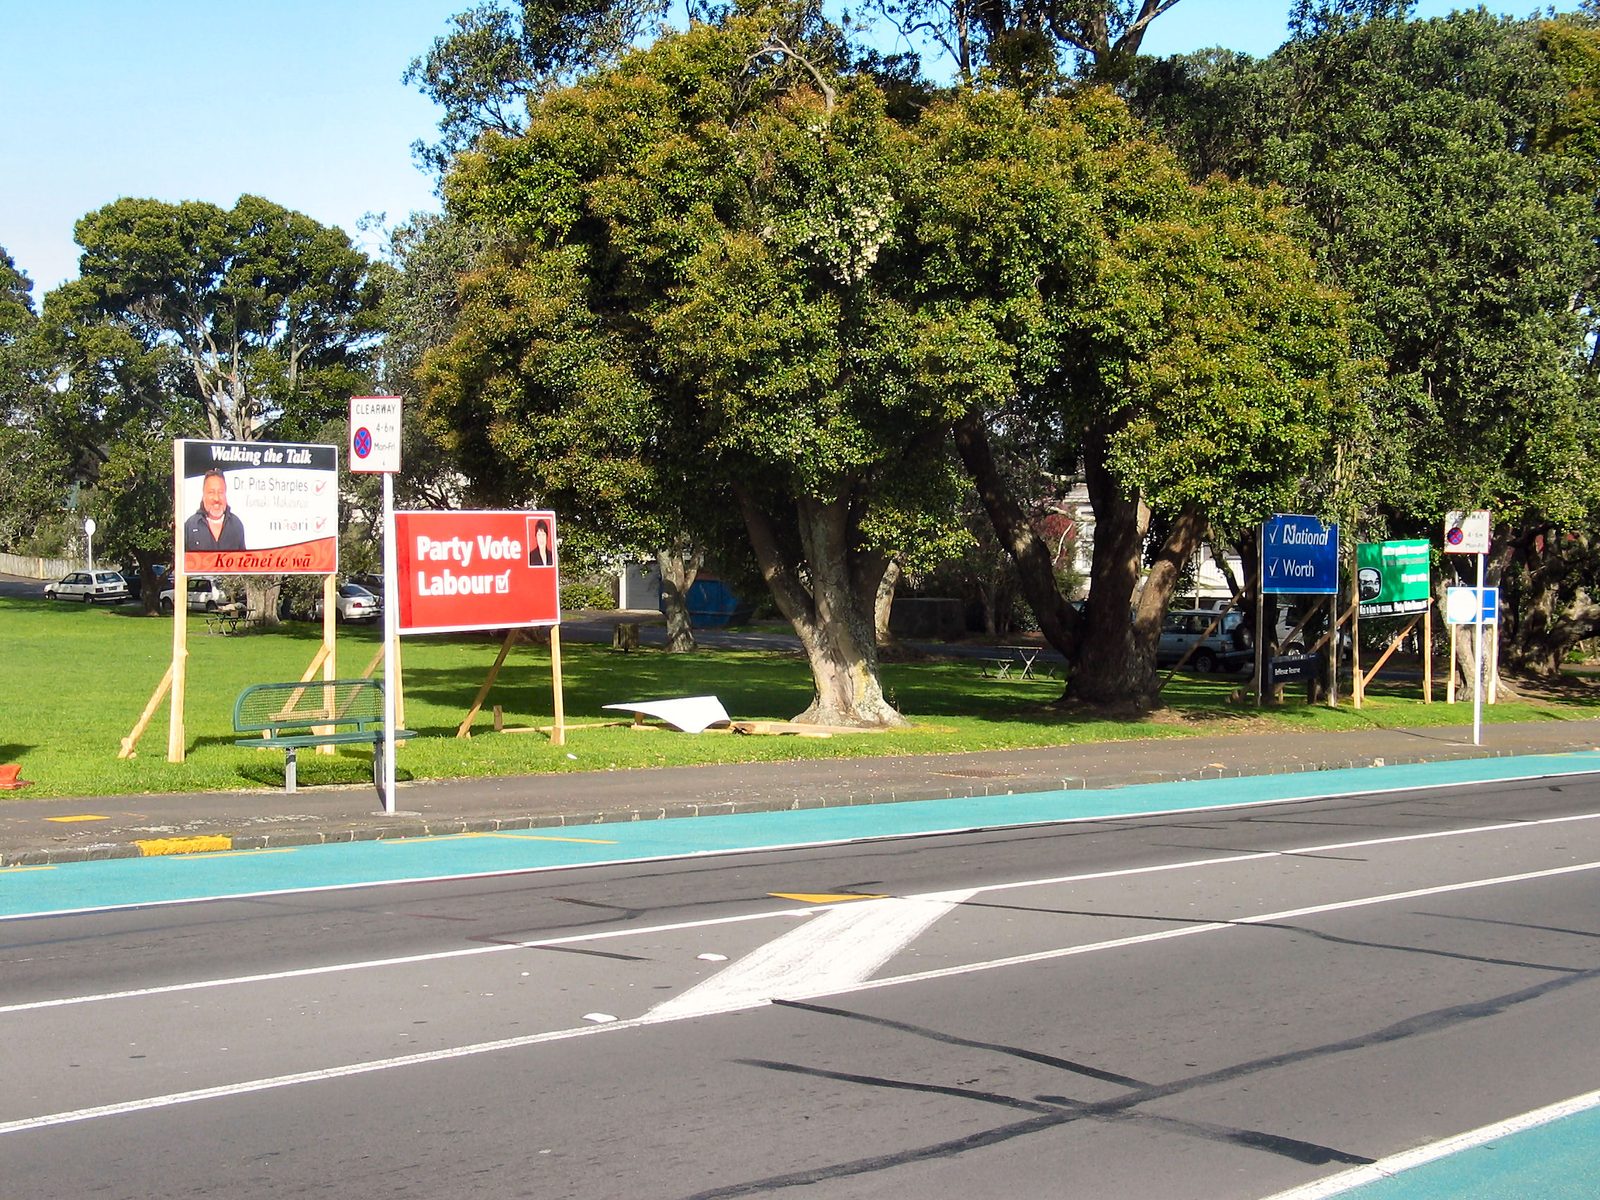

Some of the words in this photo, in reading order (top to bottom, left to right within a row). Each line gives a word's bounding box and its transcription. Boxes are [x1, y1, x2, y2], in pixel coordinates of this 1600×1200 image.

[355, 404, 396, 415] CLEARWAY
[210, 445, 261, 467] Walking
[263, 447, 283, 464] the
[286, 449, 312, 465] Talk
[249, 477, 266, 492] Pita
[268, 479, 309, 495] Sharples
[1282, 523, 1329, 546] National
[214, 553, 234, 568] Ko
[238, 553, 273, 568] tēnei
[276, 555, 288, 568] te
[292, 553, 311, 568] wā
[416, 535, 474, 568] Party
[477, 535, 522, 560] Vote
[1282, 559, 1315, 578] Worth
[417, 569, 494, 596] Labour
